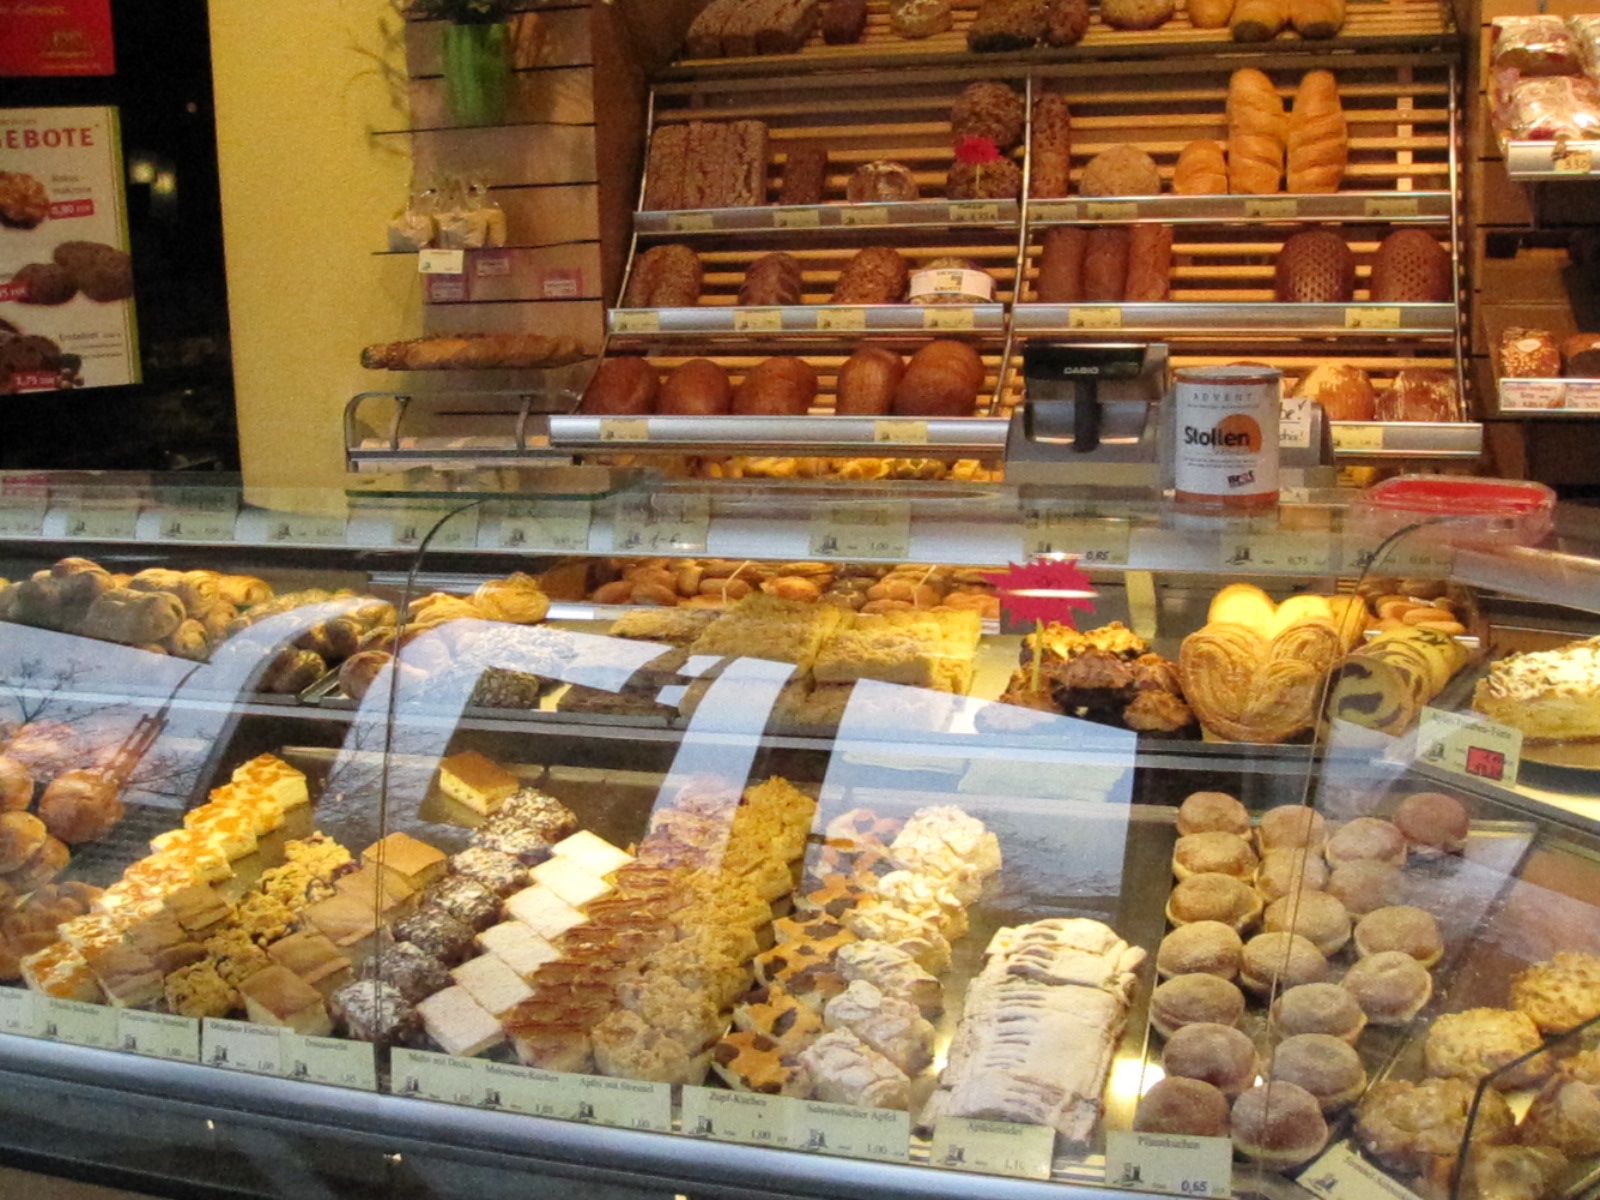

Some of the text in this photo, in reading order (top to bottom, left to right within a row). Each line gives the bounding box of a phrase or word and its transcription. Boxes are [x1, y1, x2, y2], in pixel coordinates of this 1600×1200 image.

[0, 128, 95, 149] EBOTE
[1063, 366, 1099, 375] CASIO
[1193, 392, 1253, 402] ADVENT
[1184, 425, 1251, 449] Stollen
[1180, 1180, 1208, 1194] 0,65
